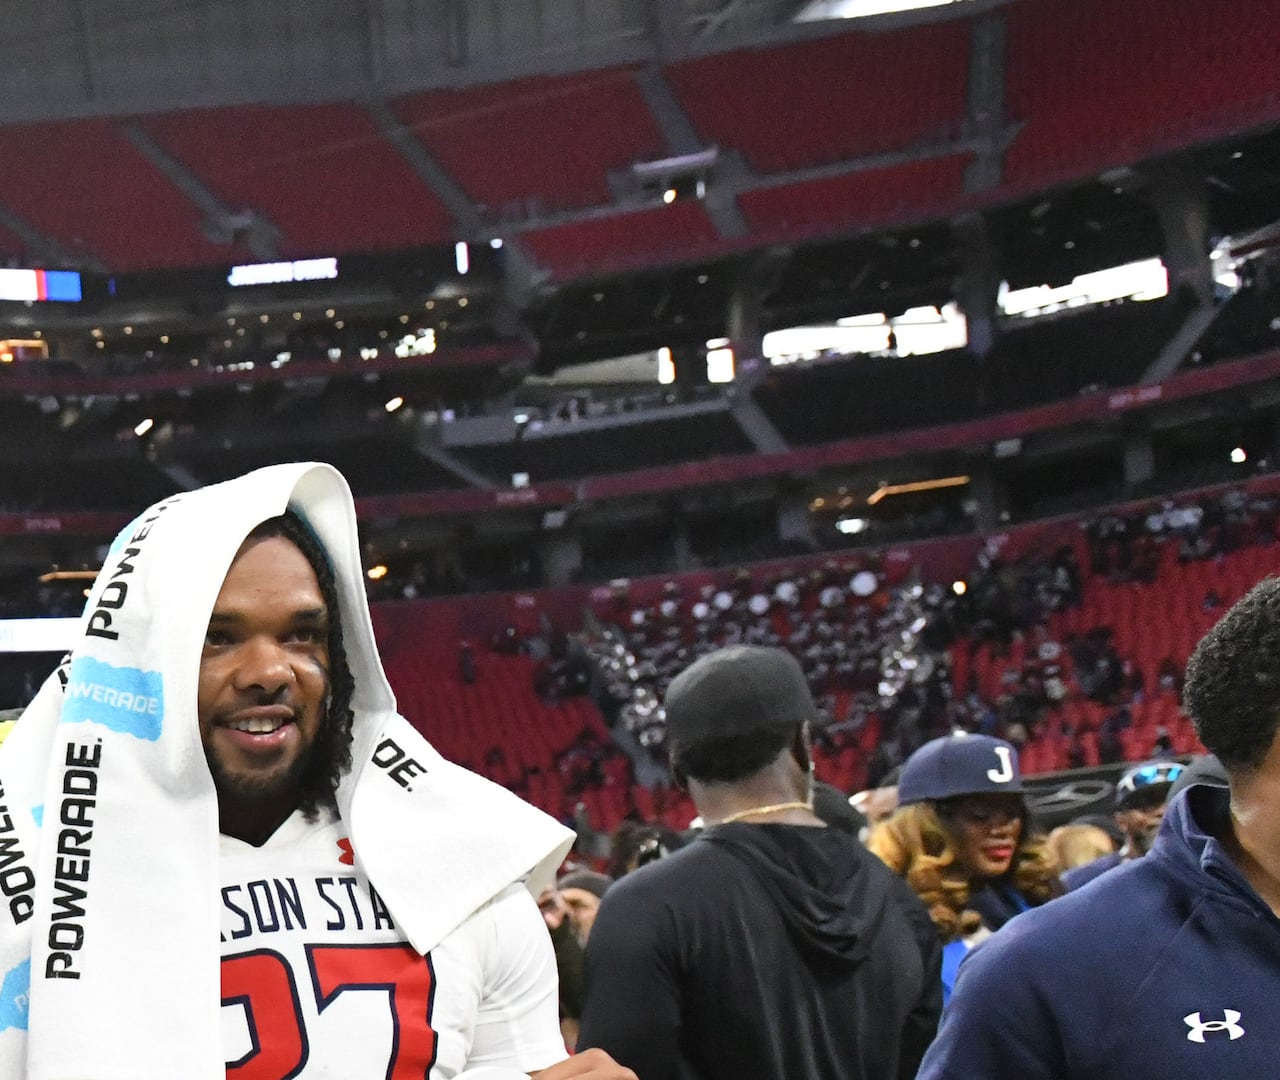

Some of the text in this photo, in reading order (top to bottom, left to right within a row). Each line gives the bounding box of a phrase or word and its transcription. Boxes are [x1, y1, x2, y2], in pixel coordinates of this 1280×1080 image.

[987, 746, 1013, 784] J
[46, 737, 103, 980] POWERADE.
[315, 877, 396, 931] STA
